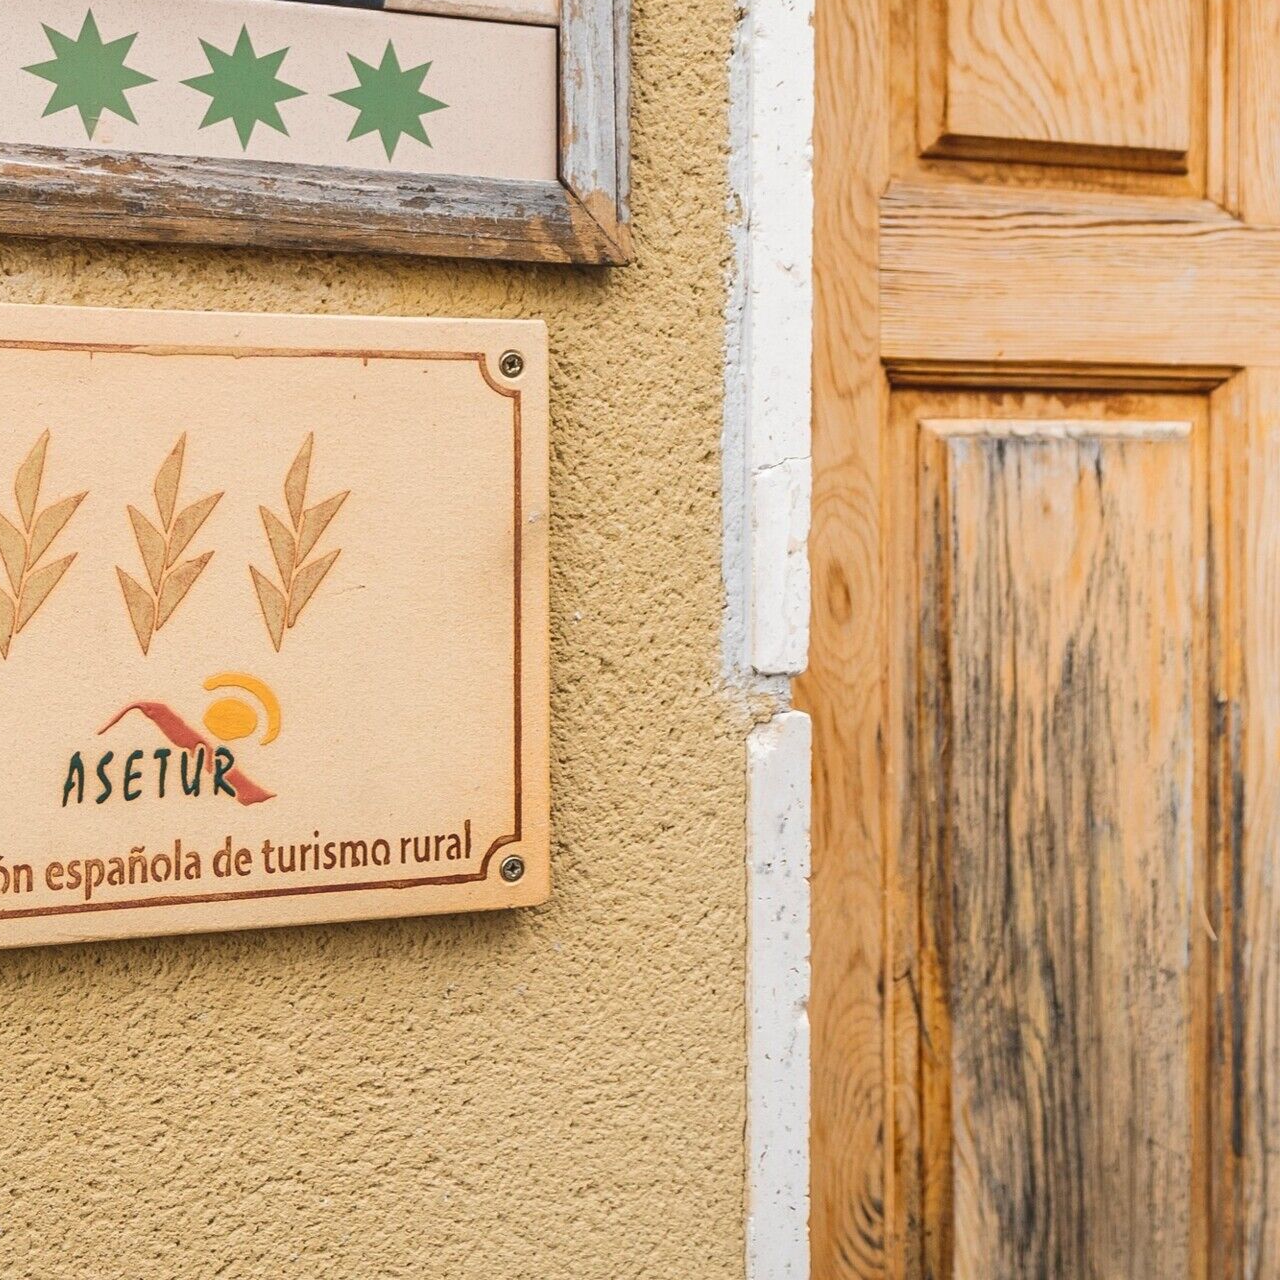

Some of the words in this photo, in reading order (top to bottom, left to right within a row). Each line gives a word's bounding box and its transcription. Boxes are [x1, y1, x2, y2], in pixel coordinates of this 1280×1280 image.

[61, 745, 237, 808] ASETUR
[45, 838, 202, 901] española
[212, 834, 253, 878] de
[260, 829, 391, 874] turismo
[400, 818, 471, 865] rural
